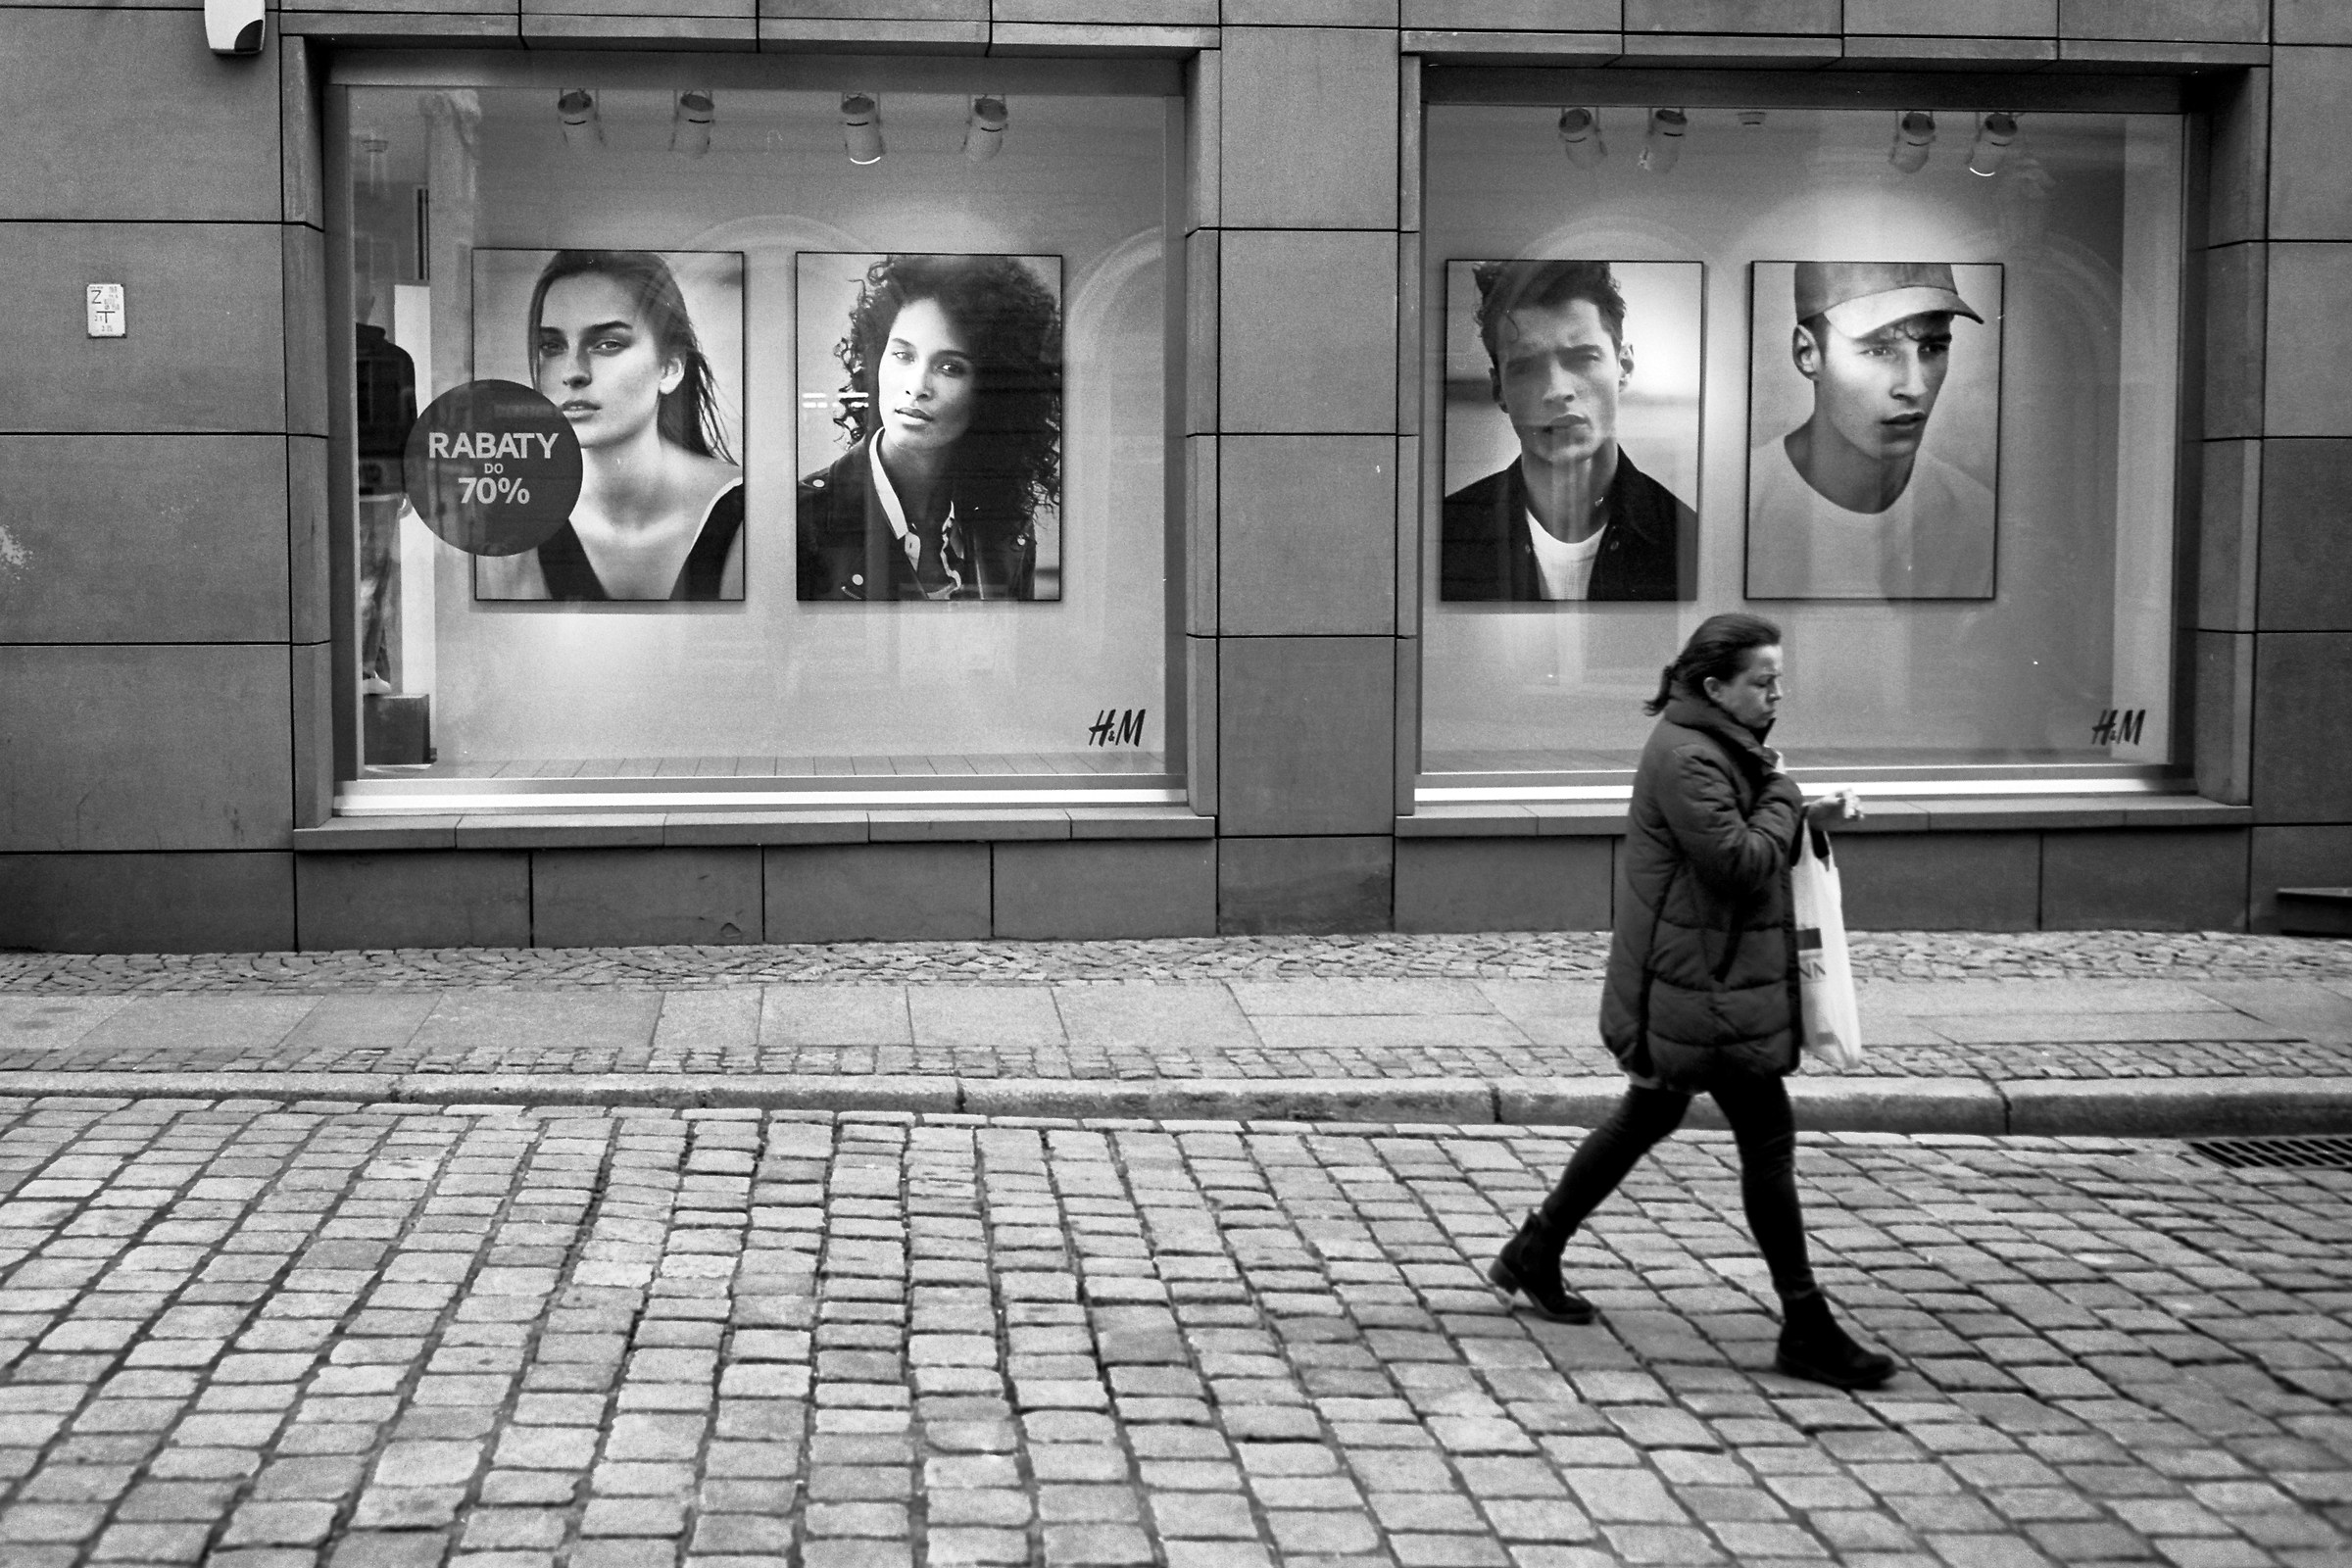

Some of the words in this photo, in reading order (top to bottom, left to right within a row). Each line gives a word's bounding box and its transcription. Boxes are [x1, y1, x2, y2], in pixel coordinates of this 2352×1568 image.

[91, 289, 102, 304] Z
[428, 432, 559, 459] RABATY
[484, 463, 504, 474] DO
[458, 477, 530, 505] 70%
[1088, 709, 1147, 748] H&M
[2091, 709, 2146, 746] H&M
